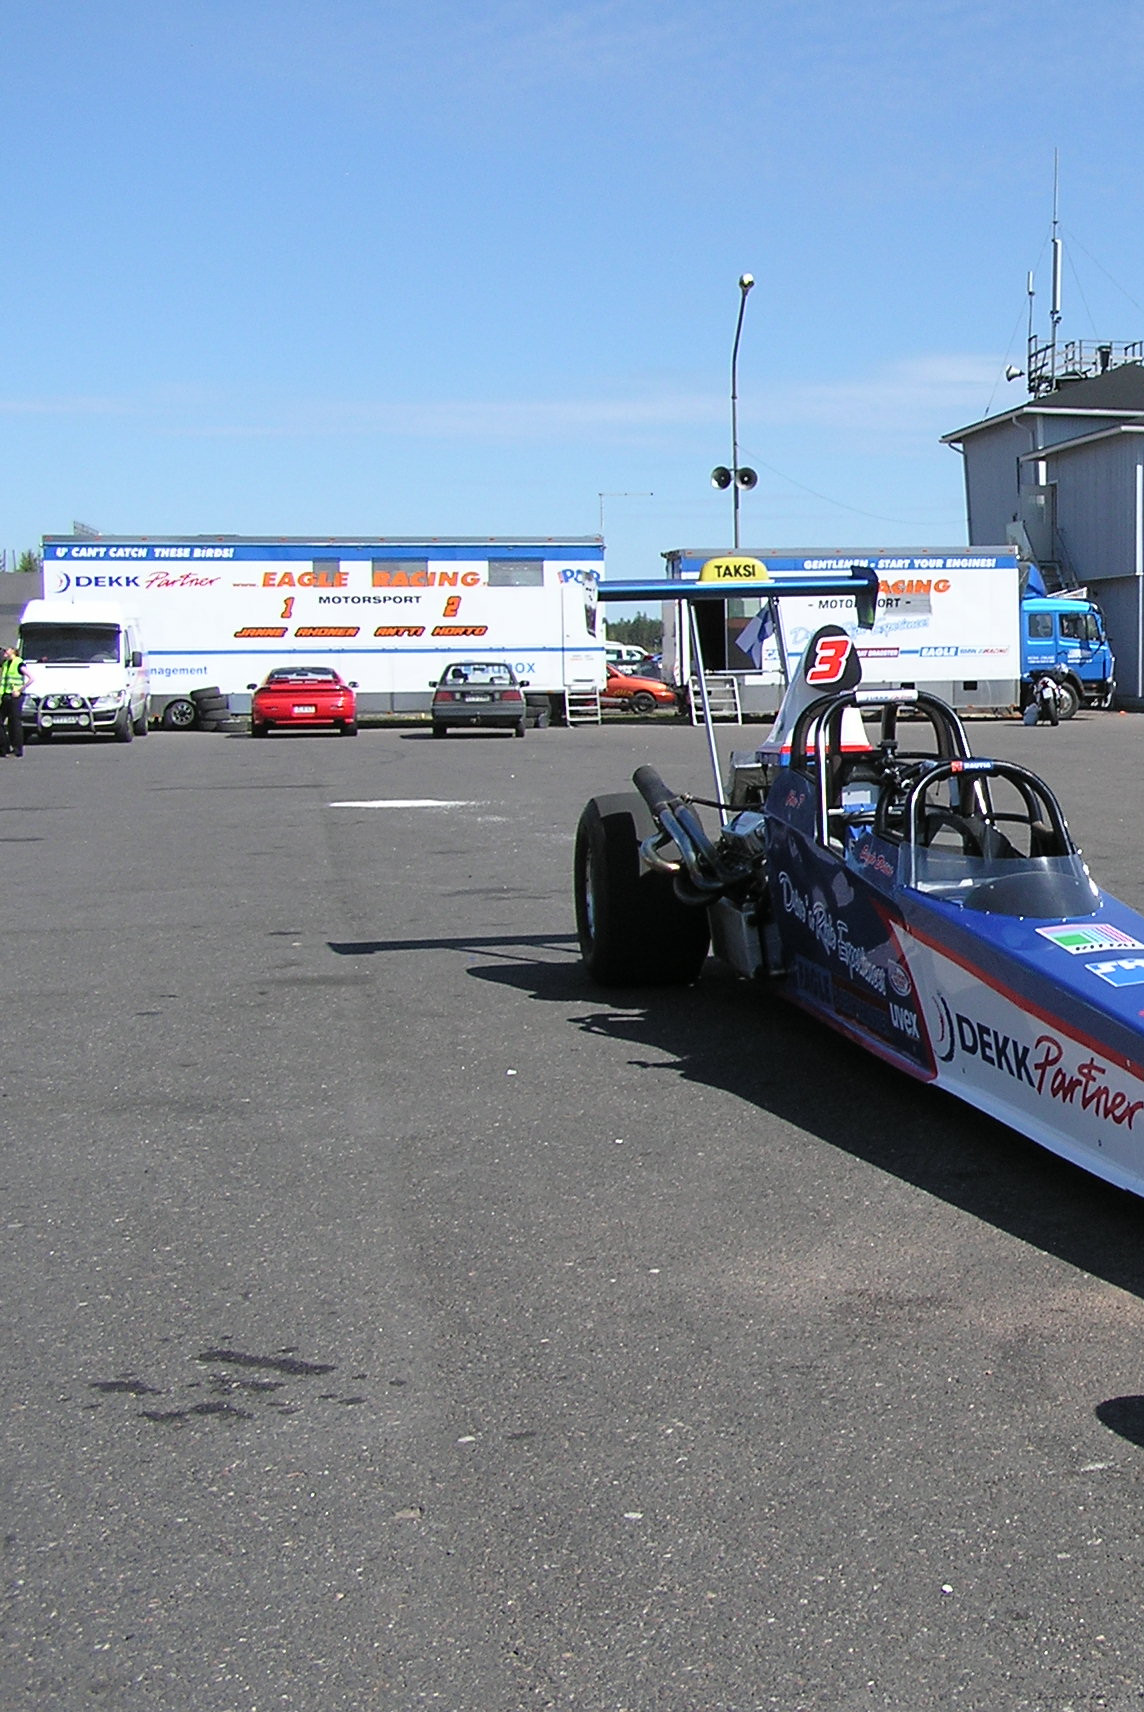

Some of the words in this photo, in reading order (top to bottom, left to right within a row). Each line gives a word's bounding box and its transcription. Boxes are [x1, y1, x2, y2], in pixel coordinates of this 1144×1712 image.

[71, 548, 106, 557] CAN'T
[109, 548, 147, 558] CATCH
[154, 548, 191, 558] THESE
[804, 560, 868, 569] GENTLEMEN
[878, 560, 911, 568] START
[914, 559, 943, 568] YOUR
[946, 558, 996, 568] ENGINES!
[714, 565, 756, 578] TAKSI
[76, 576, 140, 587] DEKK
[145, 571, 221, 588] Partner
[262, 572, 349, 587] EAGLE
[877, 579, 950, 595] ACING
[280, 597, 294, 618] 1
[319, 596, 421, 604] MOTORSPORT
[443, 596, 461, 617] 2
[818, 597, 901, 609] MOTOORT
[374, 626, 425, 636] ANTTI
[921, 648, 956, 656] EAGLE
[808, 637, 851, 683] 3
[890, 1002, 919, 1040] uvex
[957, 1013, 1035, 1088] DEKK
[1034, 1035, 1144, 1130] Partner
